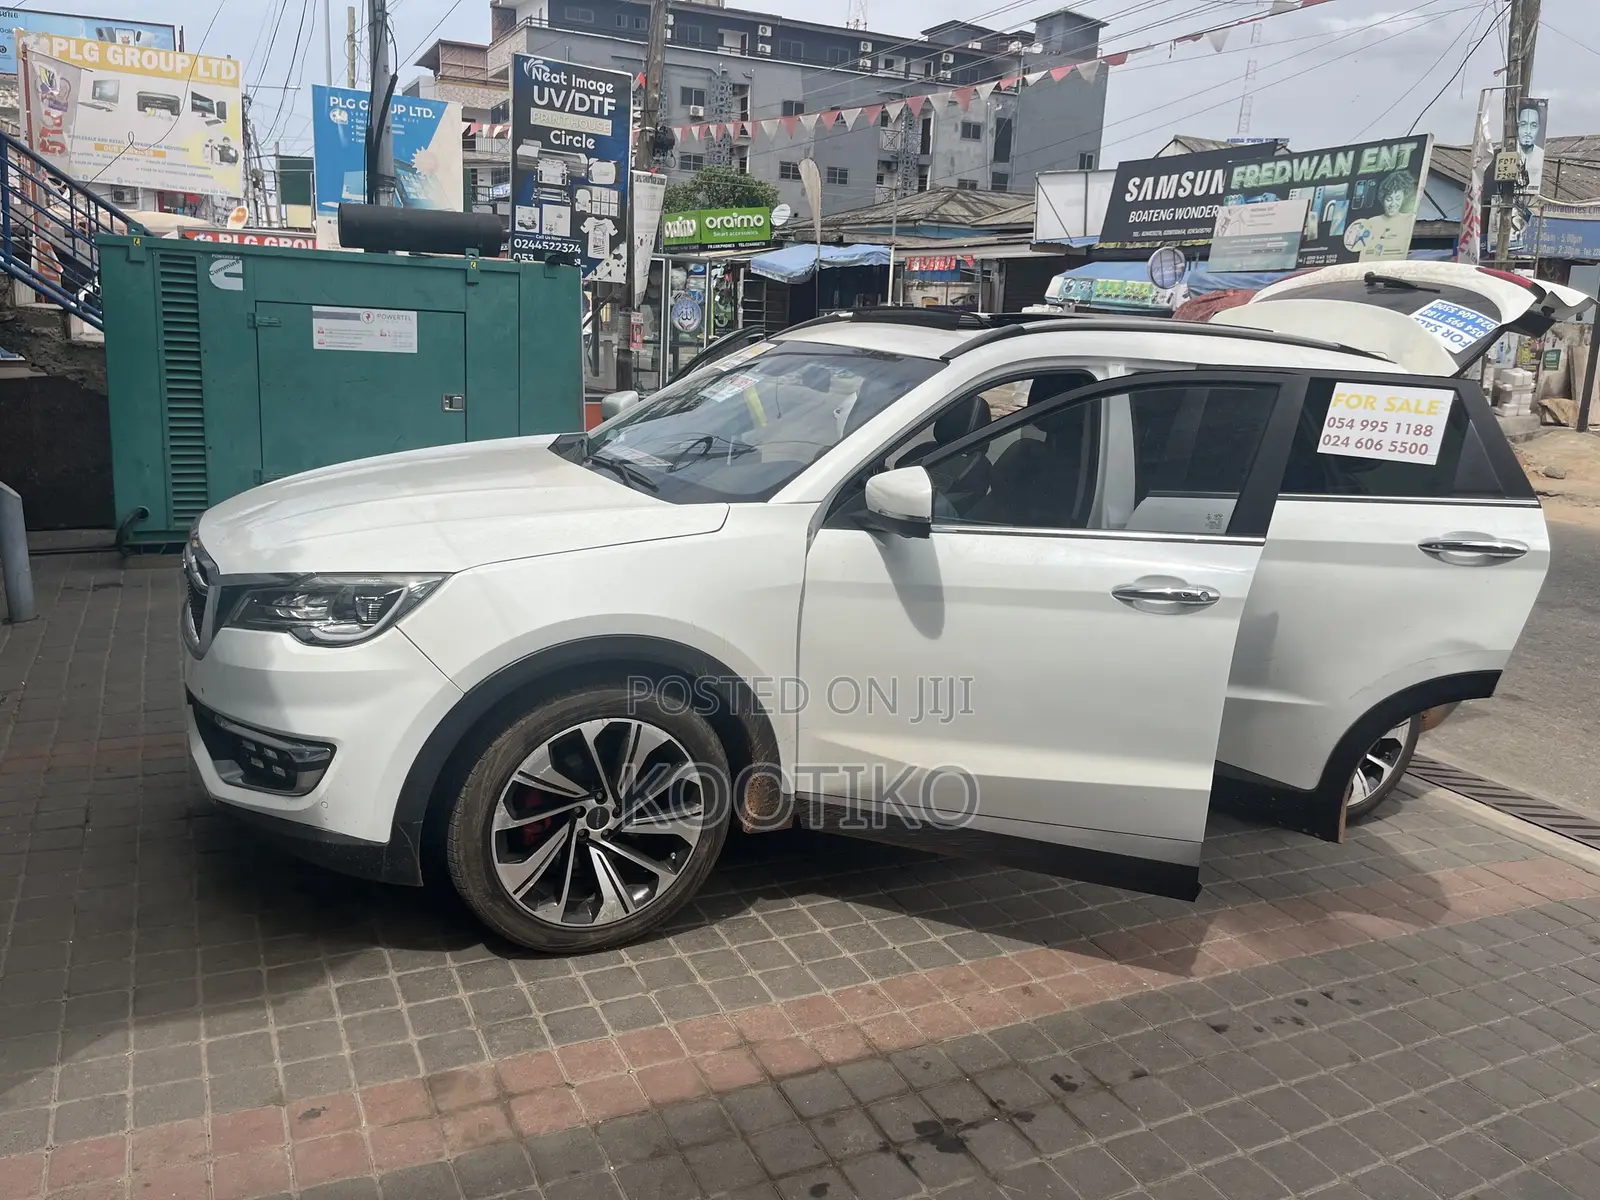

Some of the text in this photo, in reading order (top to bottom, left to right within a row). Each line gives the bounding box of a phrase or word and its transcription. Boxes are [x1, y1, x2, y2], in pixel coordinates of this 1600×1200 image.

[52, 36, 237, 81] PLG GROUP LTD
[532, 66, 615, 95] Neat Image
[329, 96, 356, 109] PLG
[359, 100, 406, 115] GUP
[409, 106, 436, 119] LTD.
[533, 85, 616, 116] UV/DTF
[40, 110, 66, 155] PLG
[532, 111, 610, 132] PRINT HOUSE
[549, 130, 596, 150] Circle
[1230, 141, 1419, 190] FREDWAN ENT
[705, 212, 765, 230] oraimo
[1128, 205, 1219, 224] BOATENG WONDER
[218, 233, 258, 246] PLG
[513, 238, 582, 254] 0244522324
[209, 260, 240, 276] Cummins
[376, 313, 413, 322] POWERTEL
[1421, 309, 1485, 338] 054 995 1188
[1433, 303, 1496, 331] 024 606 5500
[1441, 328, 1473, 348] FOR
[1331, 393, 1441, 416] FOR SALE
[1326, 416, 1434, 437] 054 995 1188
[1321, 433, 1429, 456] 024 606 5500
